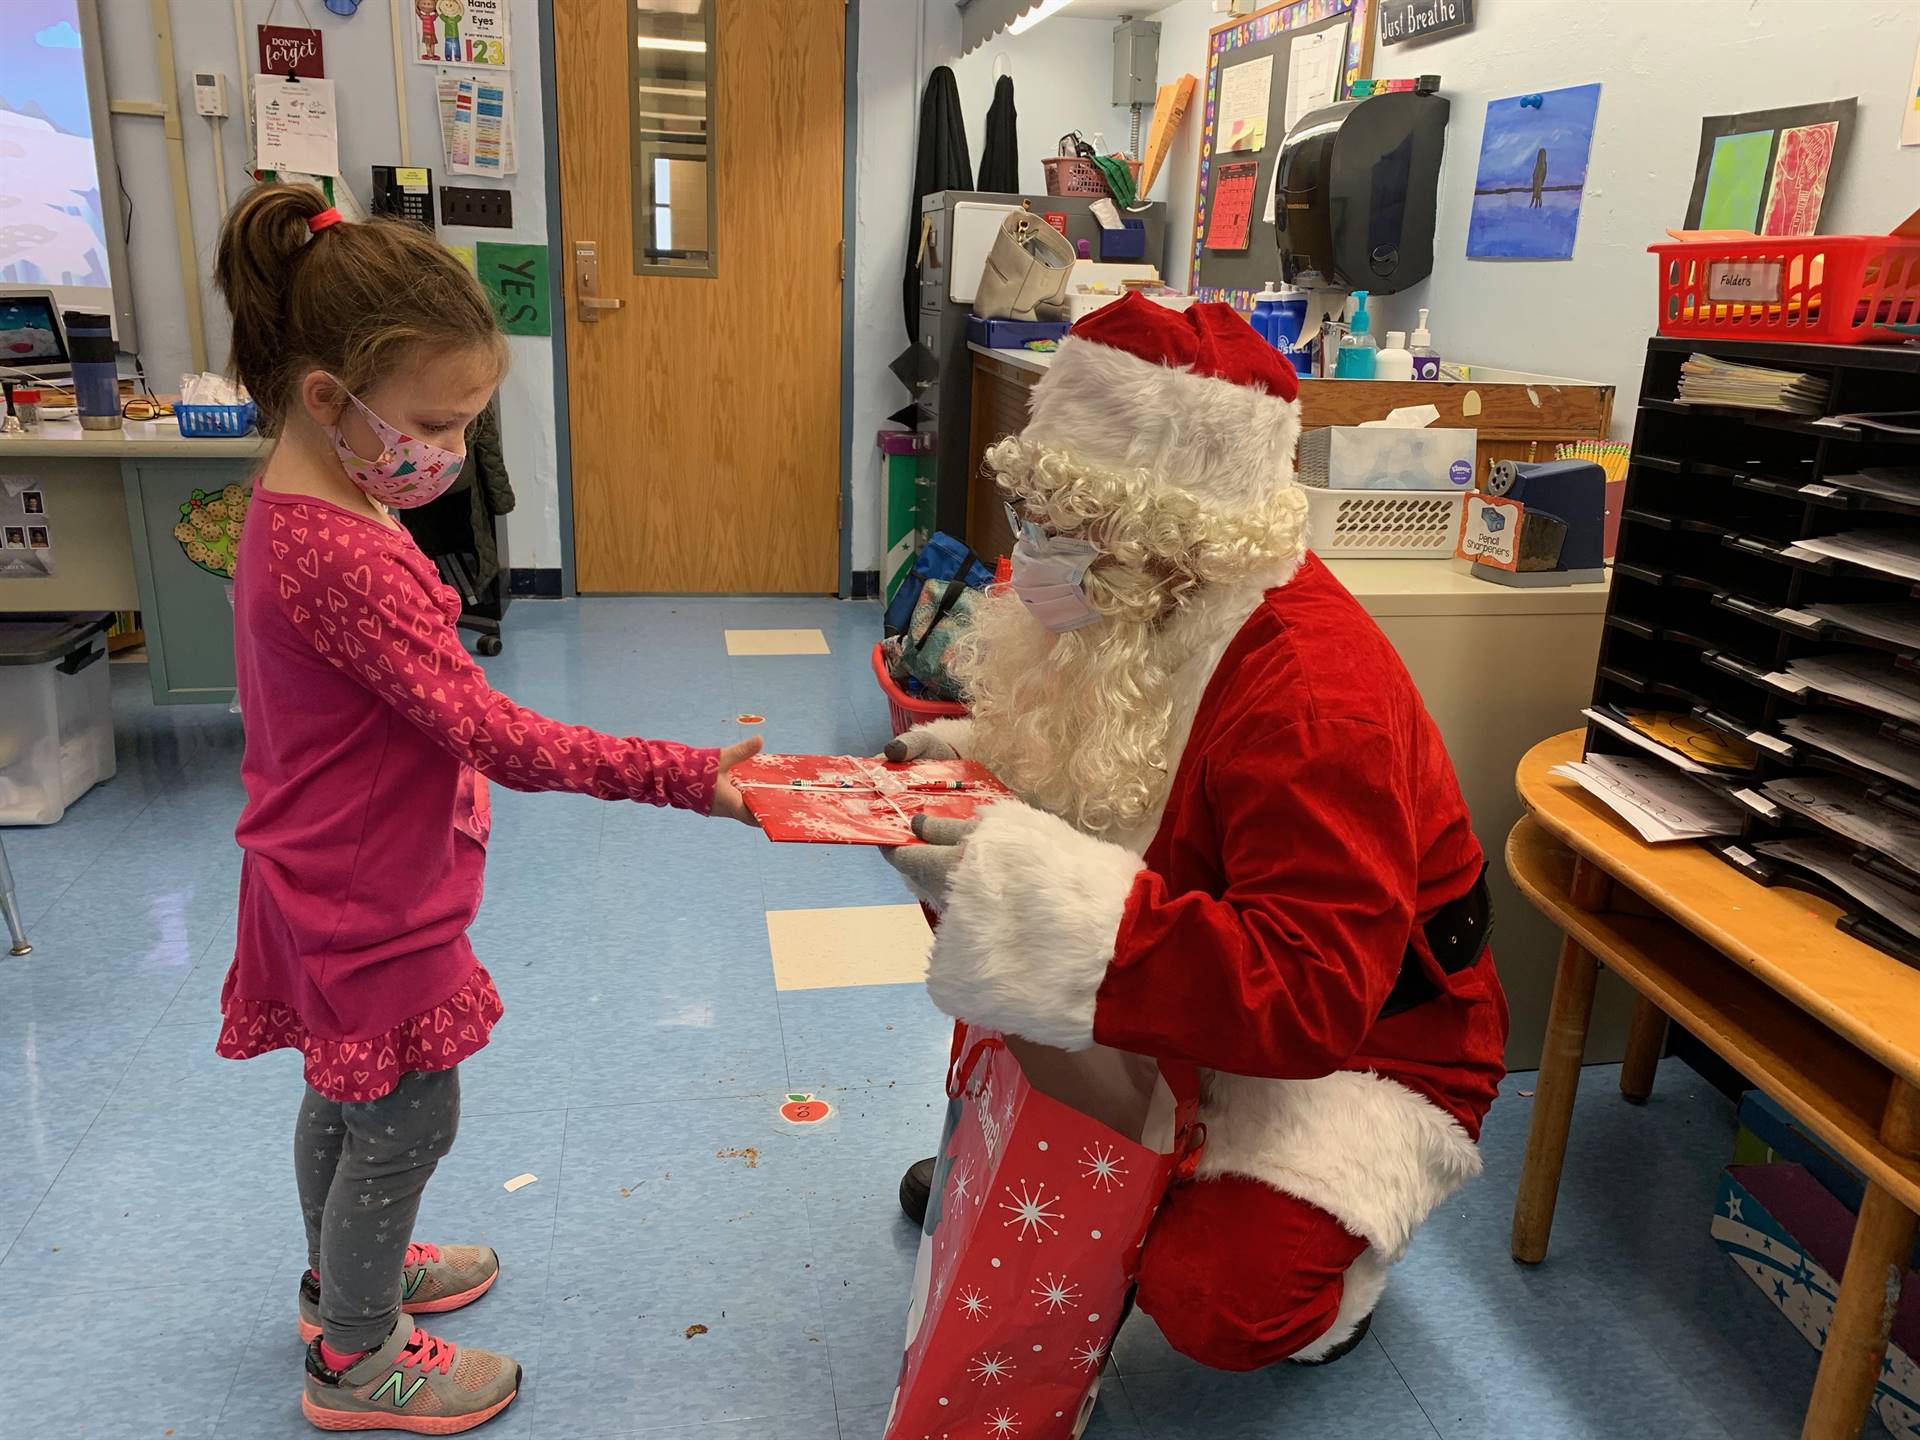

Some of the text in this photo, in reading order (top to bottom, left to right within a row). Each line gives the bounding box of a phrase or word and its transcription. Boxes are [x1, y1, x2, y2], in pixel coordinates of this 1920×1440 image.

[468, 0, 497, 9] Hands
[472, 15, 494, 26] Eyes
[1382, 11, 1405, 39] Just
[1408, 0, 1456, 34] Breathe
[271, 37, 300, 48] DON'T
[265, 38, 317, 70] forget
[1720, 273, 1752, 287] Folders
[497, 259, 538, 323] YES
[1479, 532, 1500, 546] Pencil
[369, 1370, 428, 1408] N
